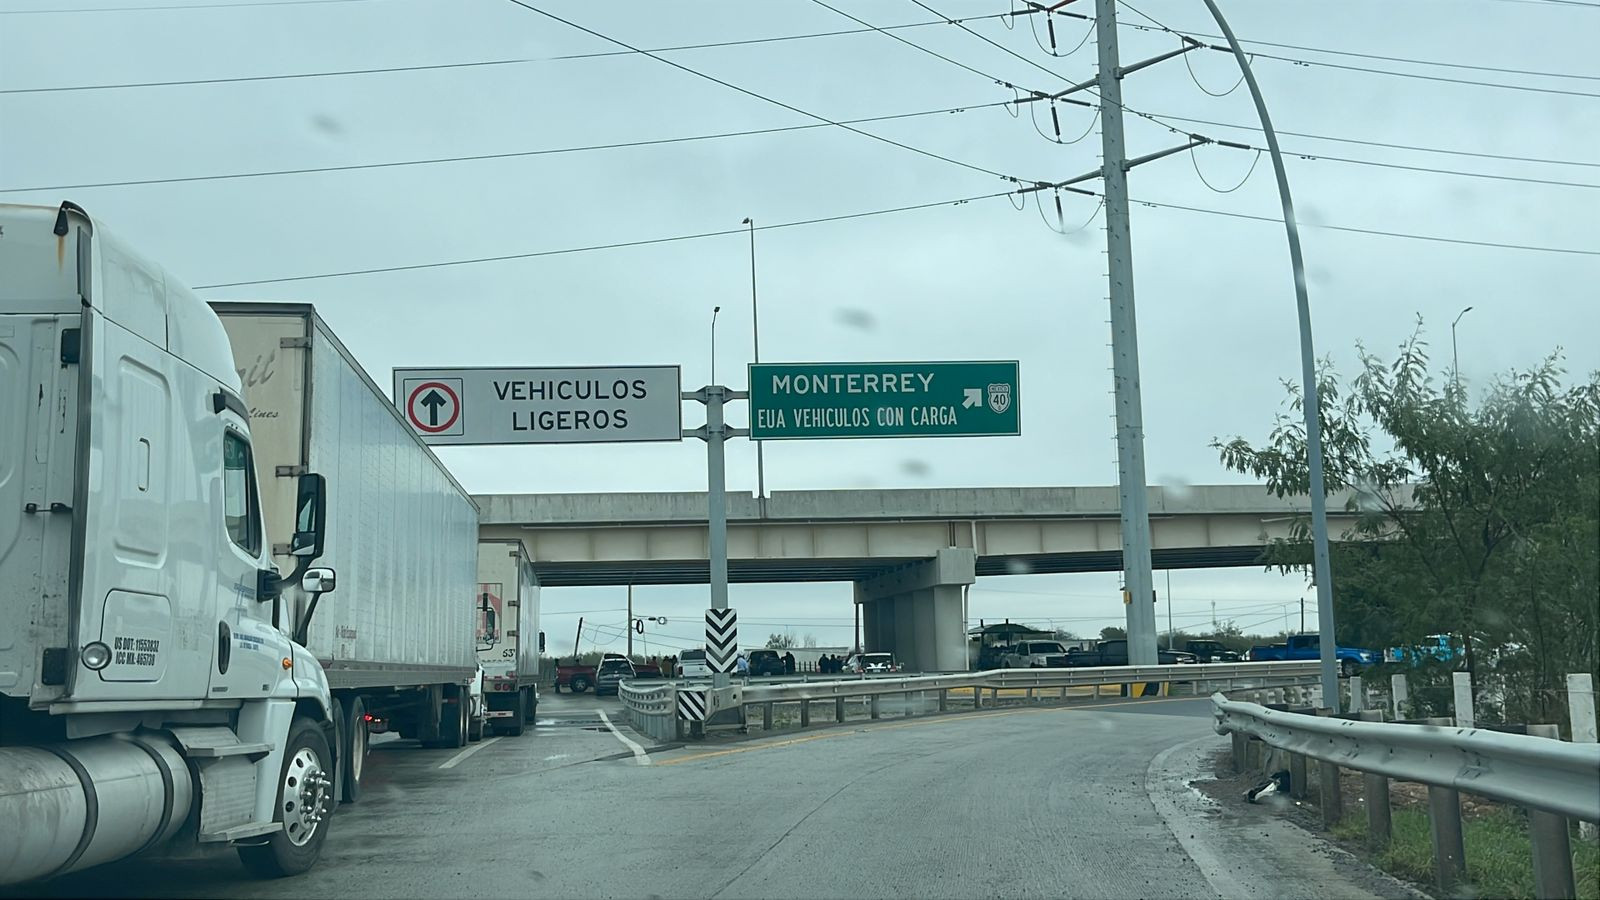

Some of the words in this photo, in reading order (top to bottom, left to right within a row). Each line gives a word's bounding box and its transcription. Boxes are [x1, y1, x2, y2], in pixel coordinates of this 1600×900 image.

[493, 379, 648, 401] VEHICULOS
[772, 372, 935, 395] MONTERREY
[993, 394, 1006, 406] 40
[512, 409, 629, 431] LIGEROS
[757, 409, 786, 429] EUA
[793, 407, 870, 428] VEHICULOS
[877, 407, 904, 427] CON
[911, 405, 958, 426] CARGA
